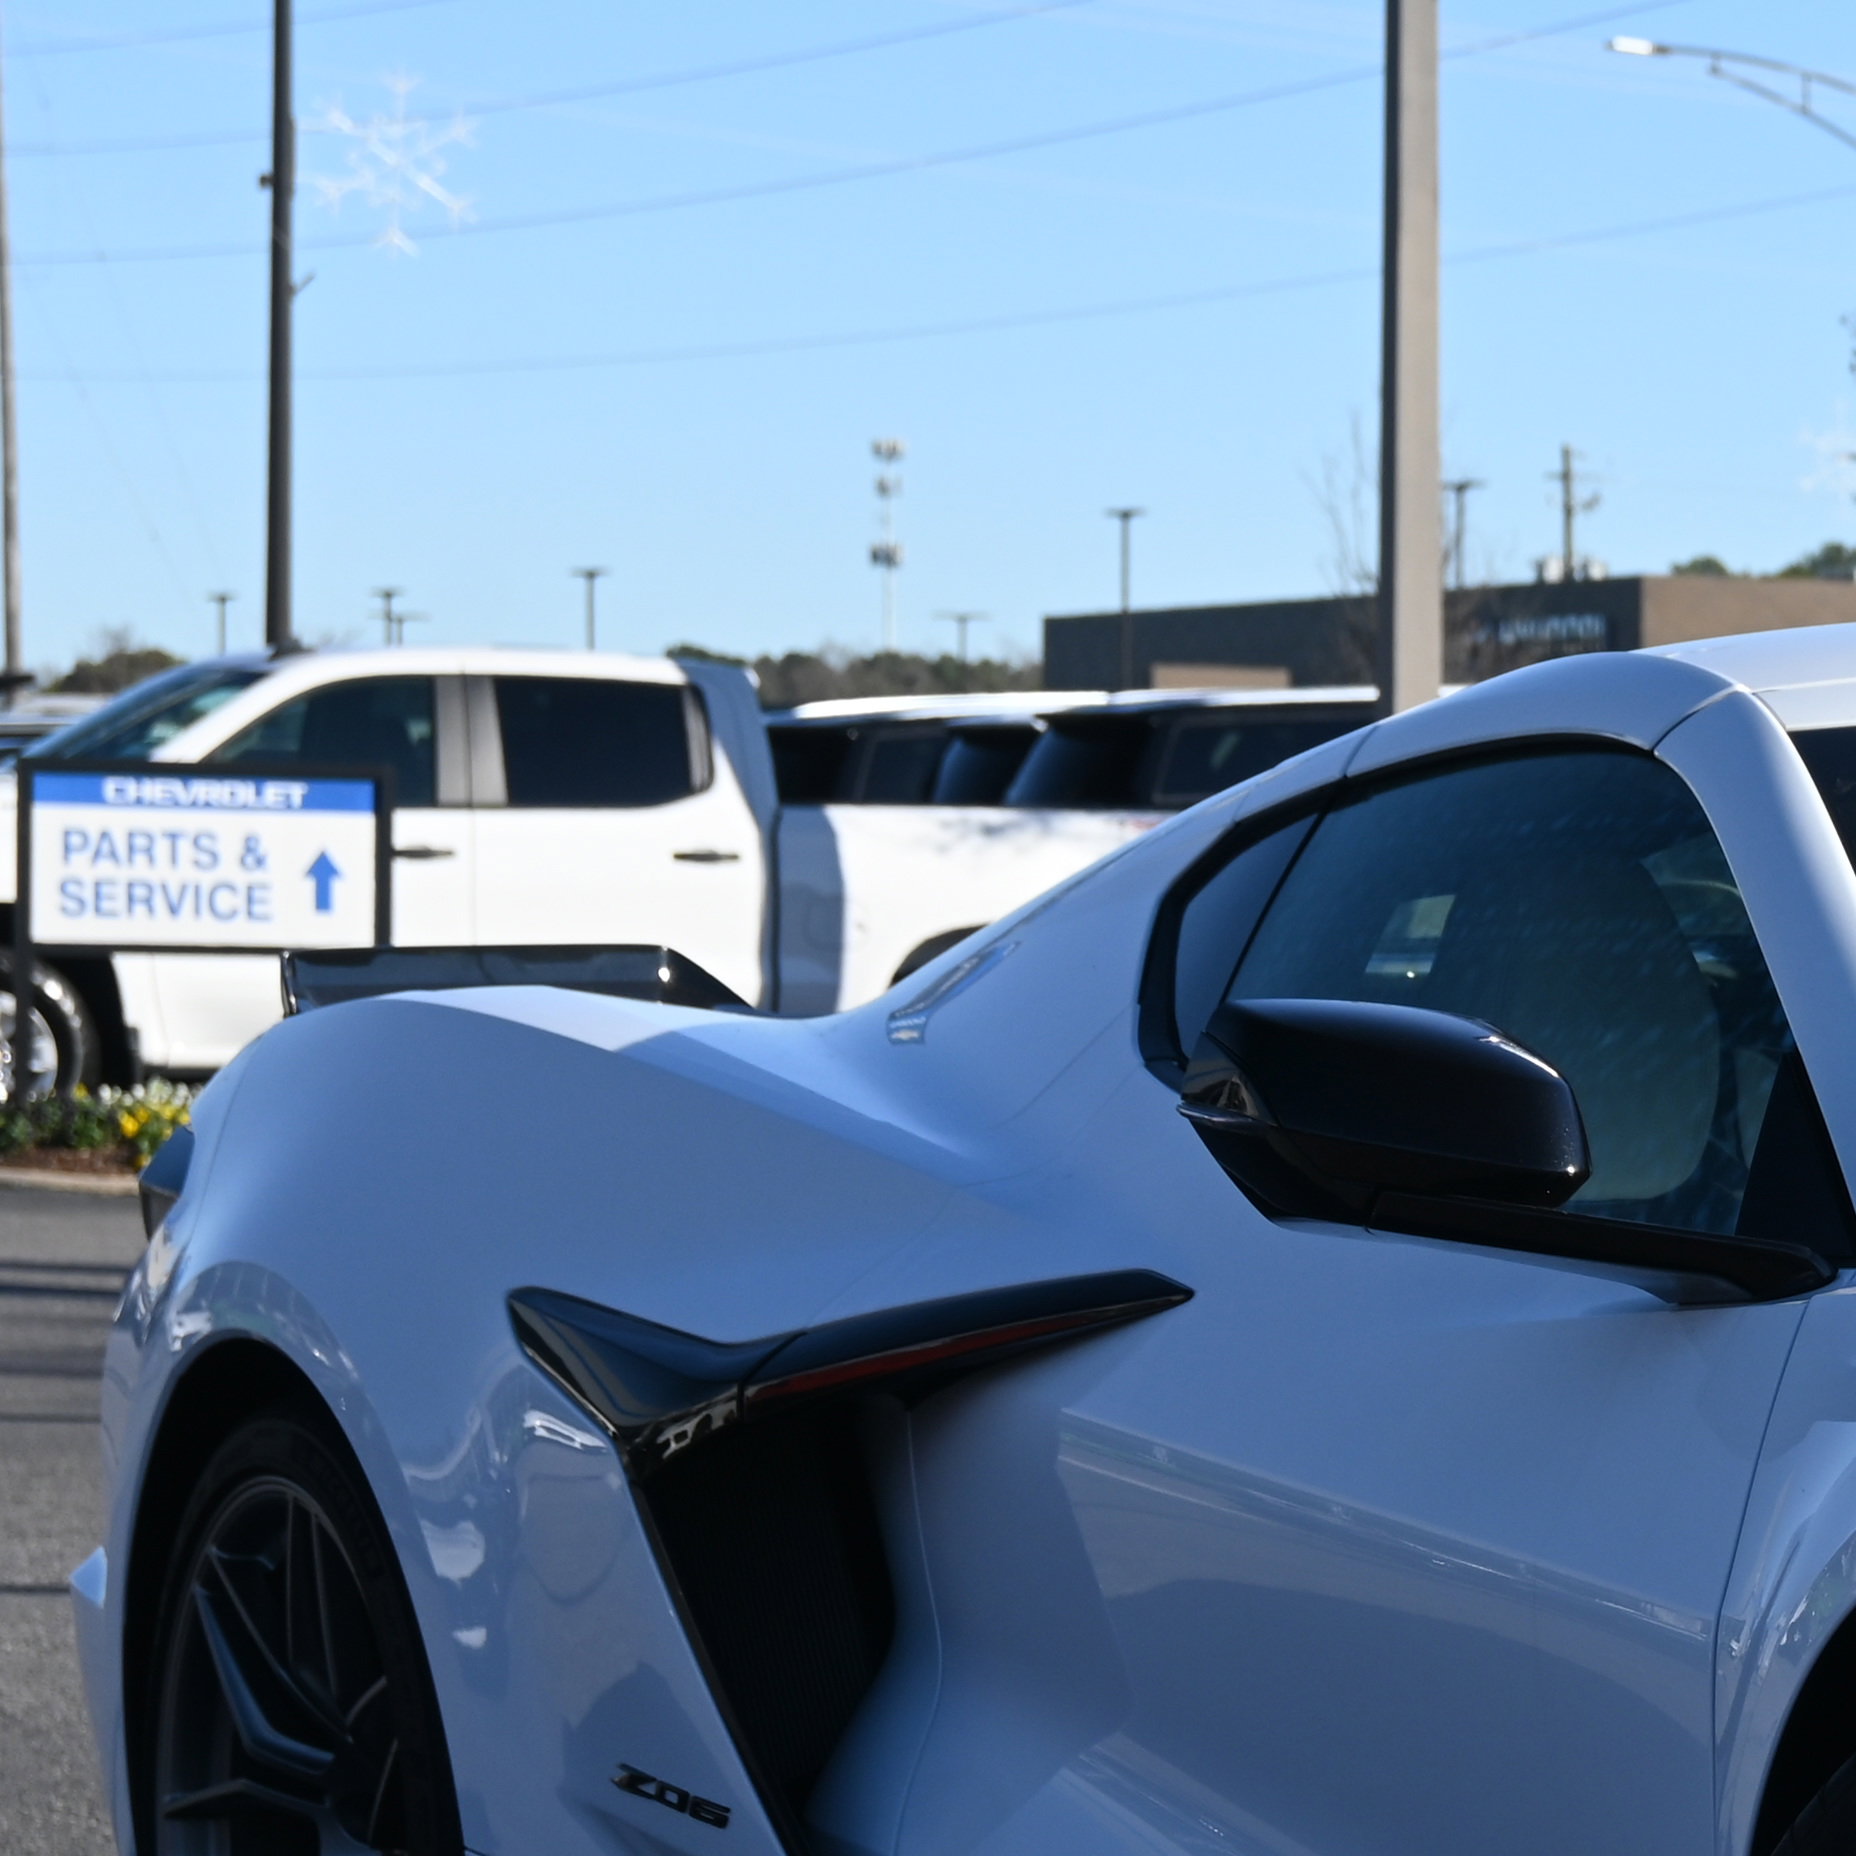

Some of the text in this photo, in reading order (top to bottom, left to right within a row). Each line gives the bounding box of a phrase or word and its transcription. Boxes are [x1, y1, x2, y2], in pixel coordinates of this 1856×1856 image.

[104, 776, 308, 809] CHEVROLET
[63, 829, 268, 871] PARTS &
[59, 878, 273, 921] SERVICE
[610, 1763, 731, 1829] Z06
